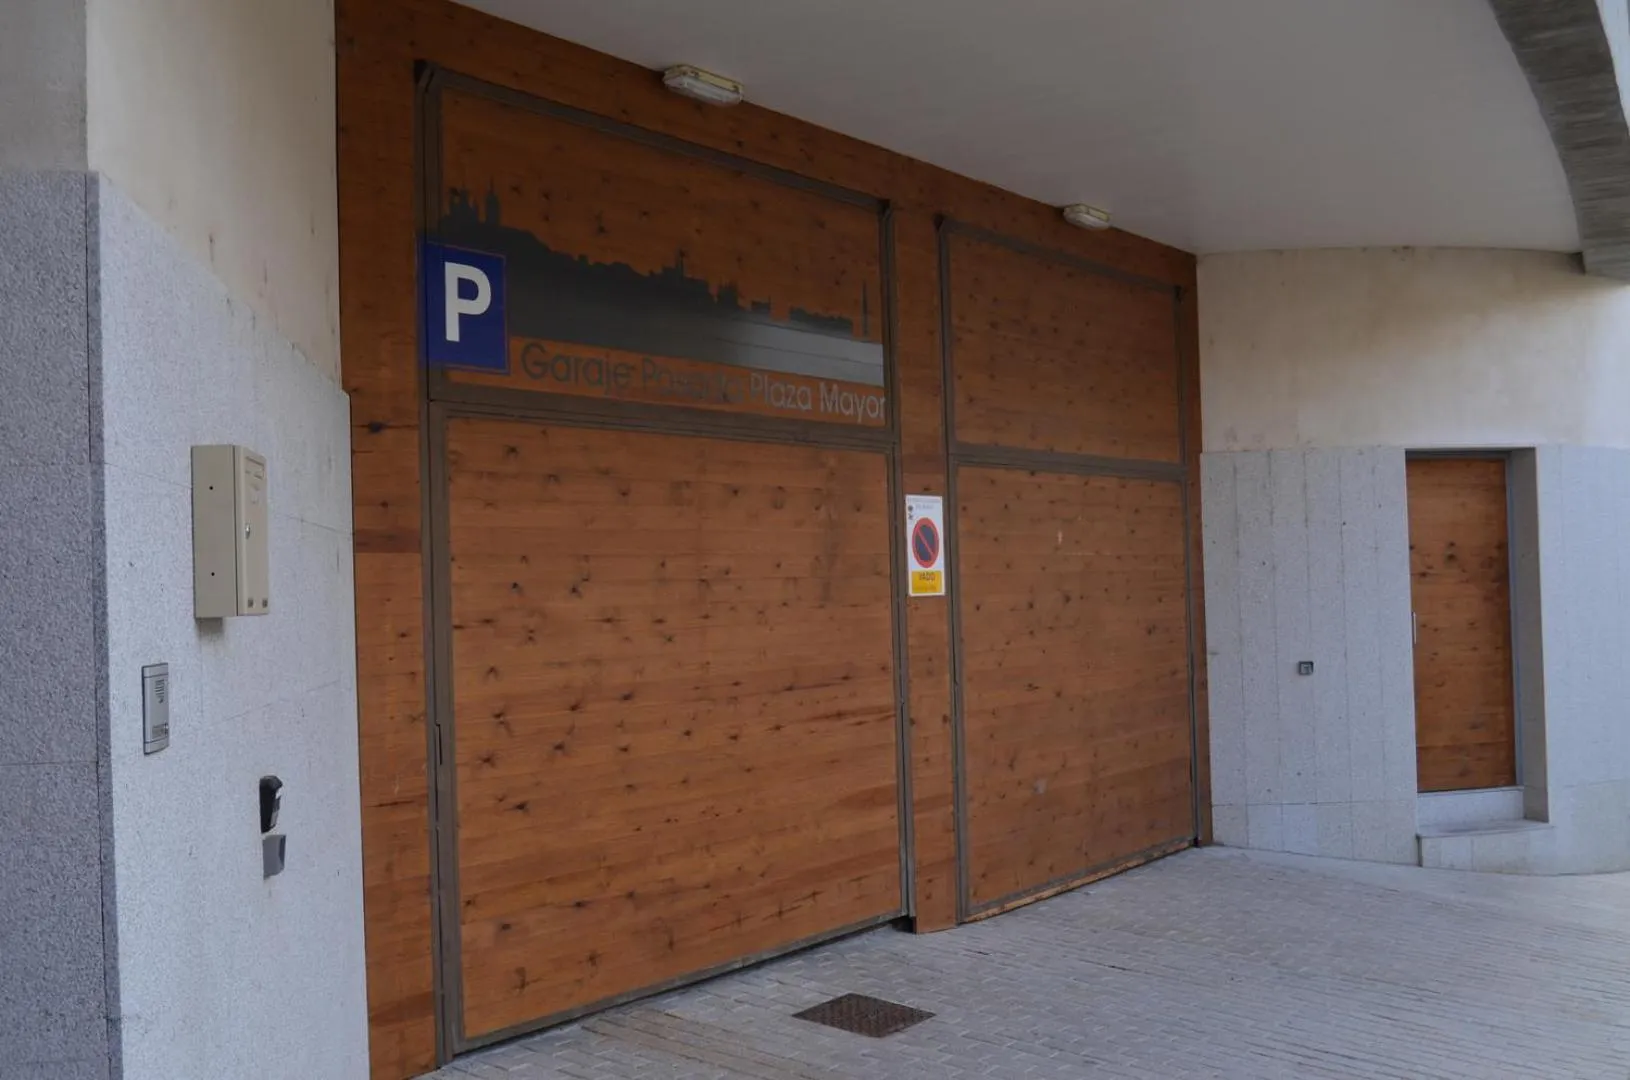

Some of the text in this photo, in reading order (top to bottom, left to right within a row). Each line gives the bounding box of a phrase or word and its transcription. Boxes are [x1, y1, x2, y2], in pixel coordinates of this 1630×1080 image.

[445, 261, 491, 342] P
[521, 342, 632, 396] Garaje
[750, 372, 812, 411] Plaza
[820, 381, 886, 424] Mayor
